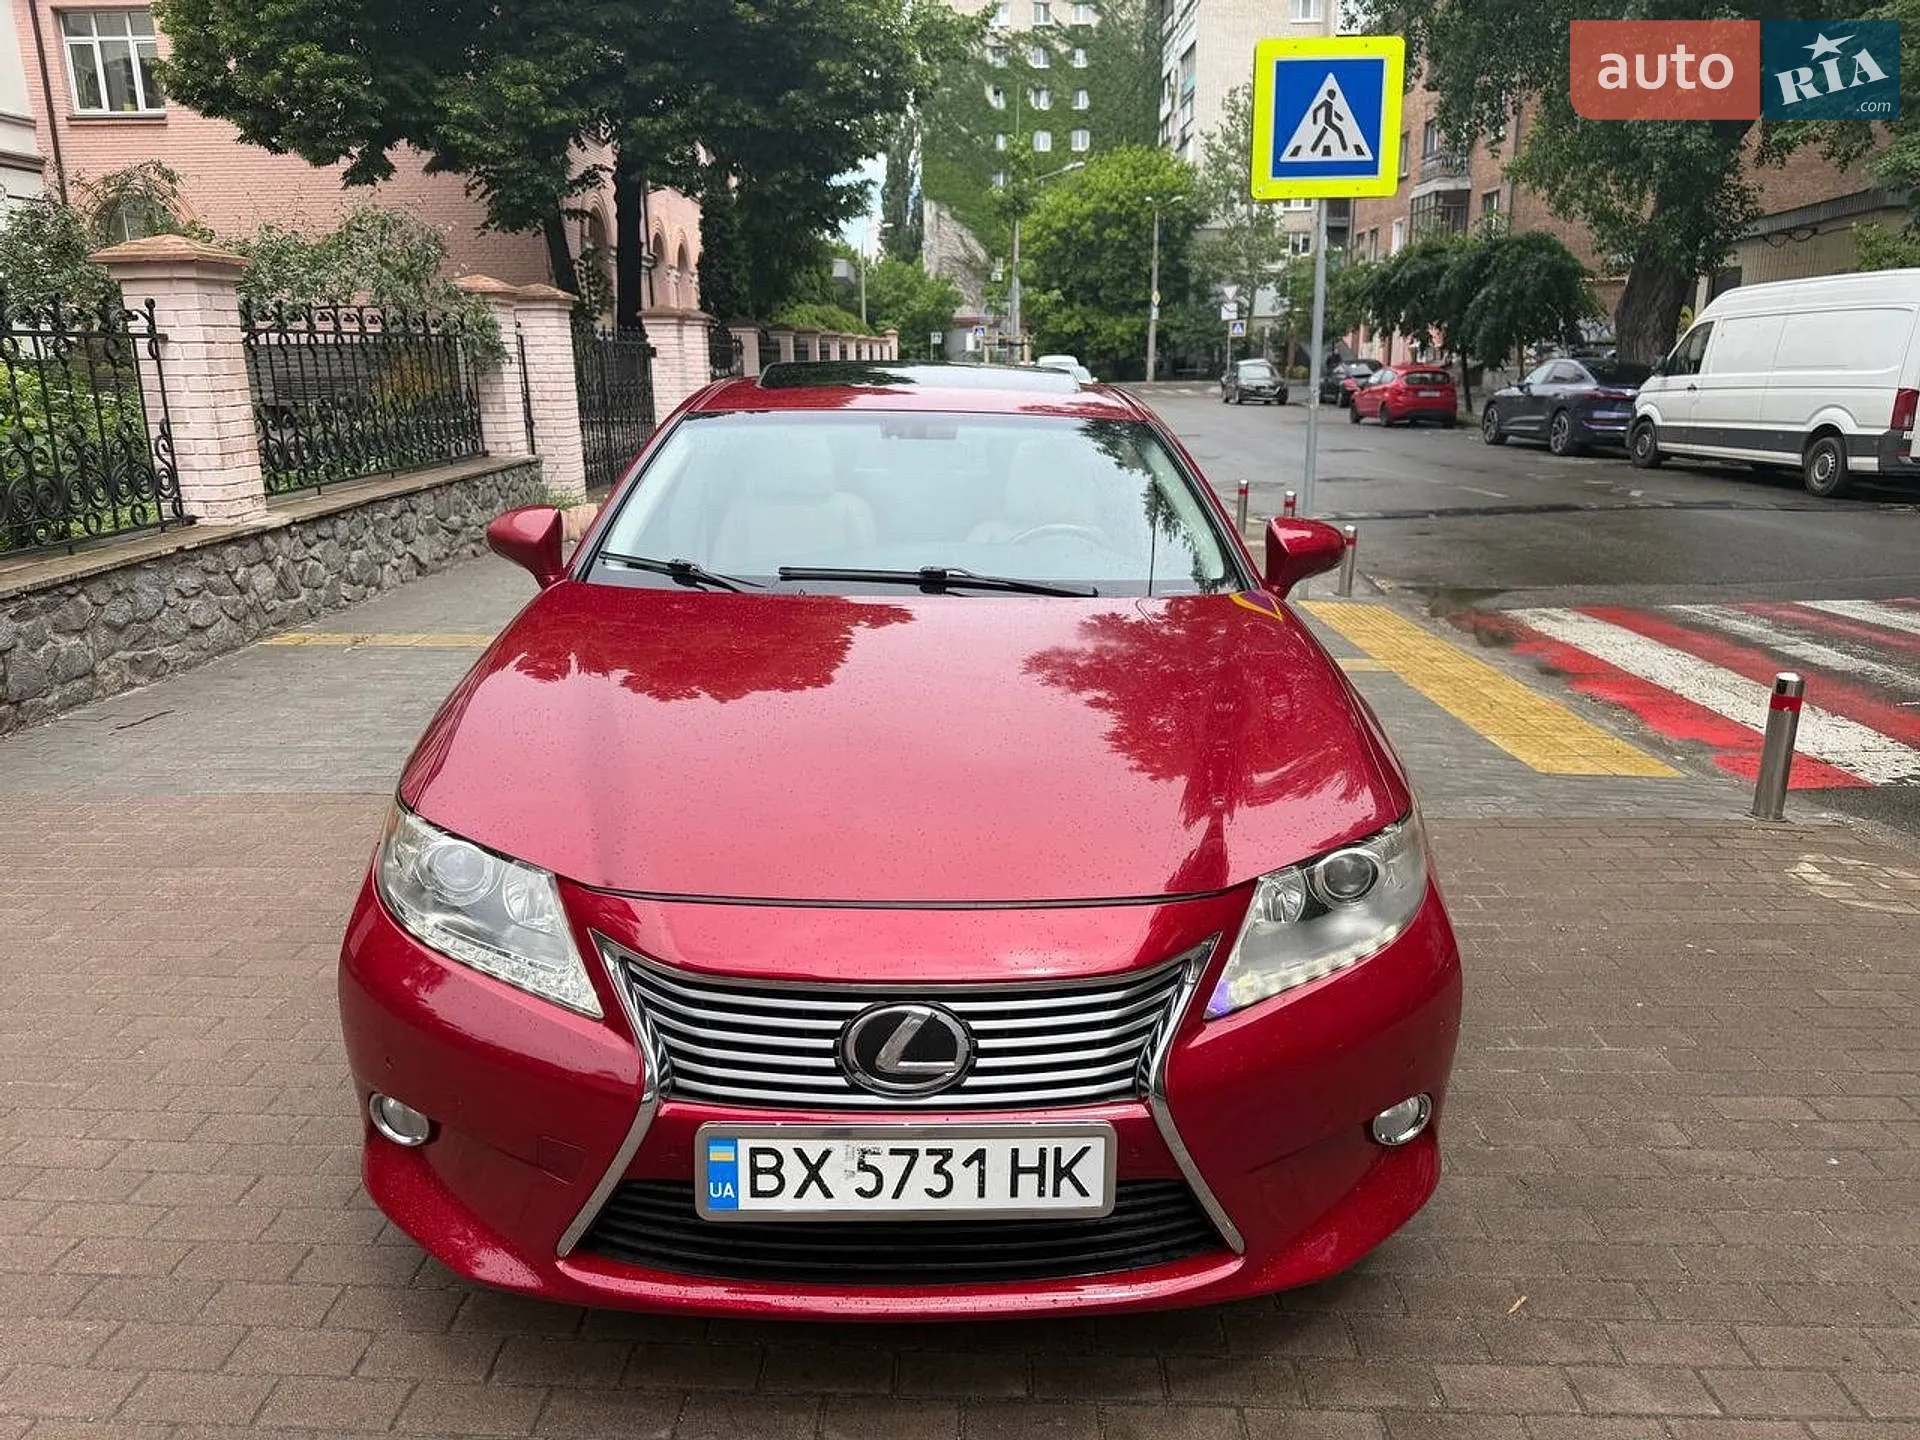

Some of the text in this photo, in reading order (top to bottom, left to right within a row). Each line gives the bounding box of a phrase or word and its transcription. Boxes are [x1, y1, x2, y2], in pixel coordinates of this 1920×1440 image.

[709, 1181, 735, 1198] UA
[748, 1145, 1092, 1199] BX 5731 HK
